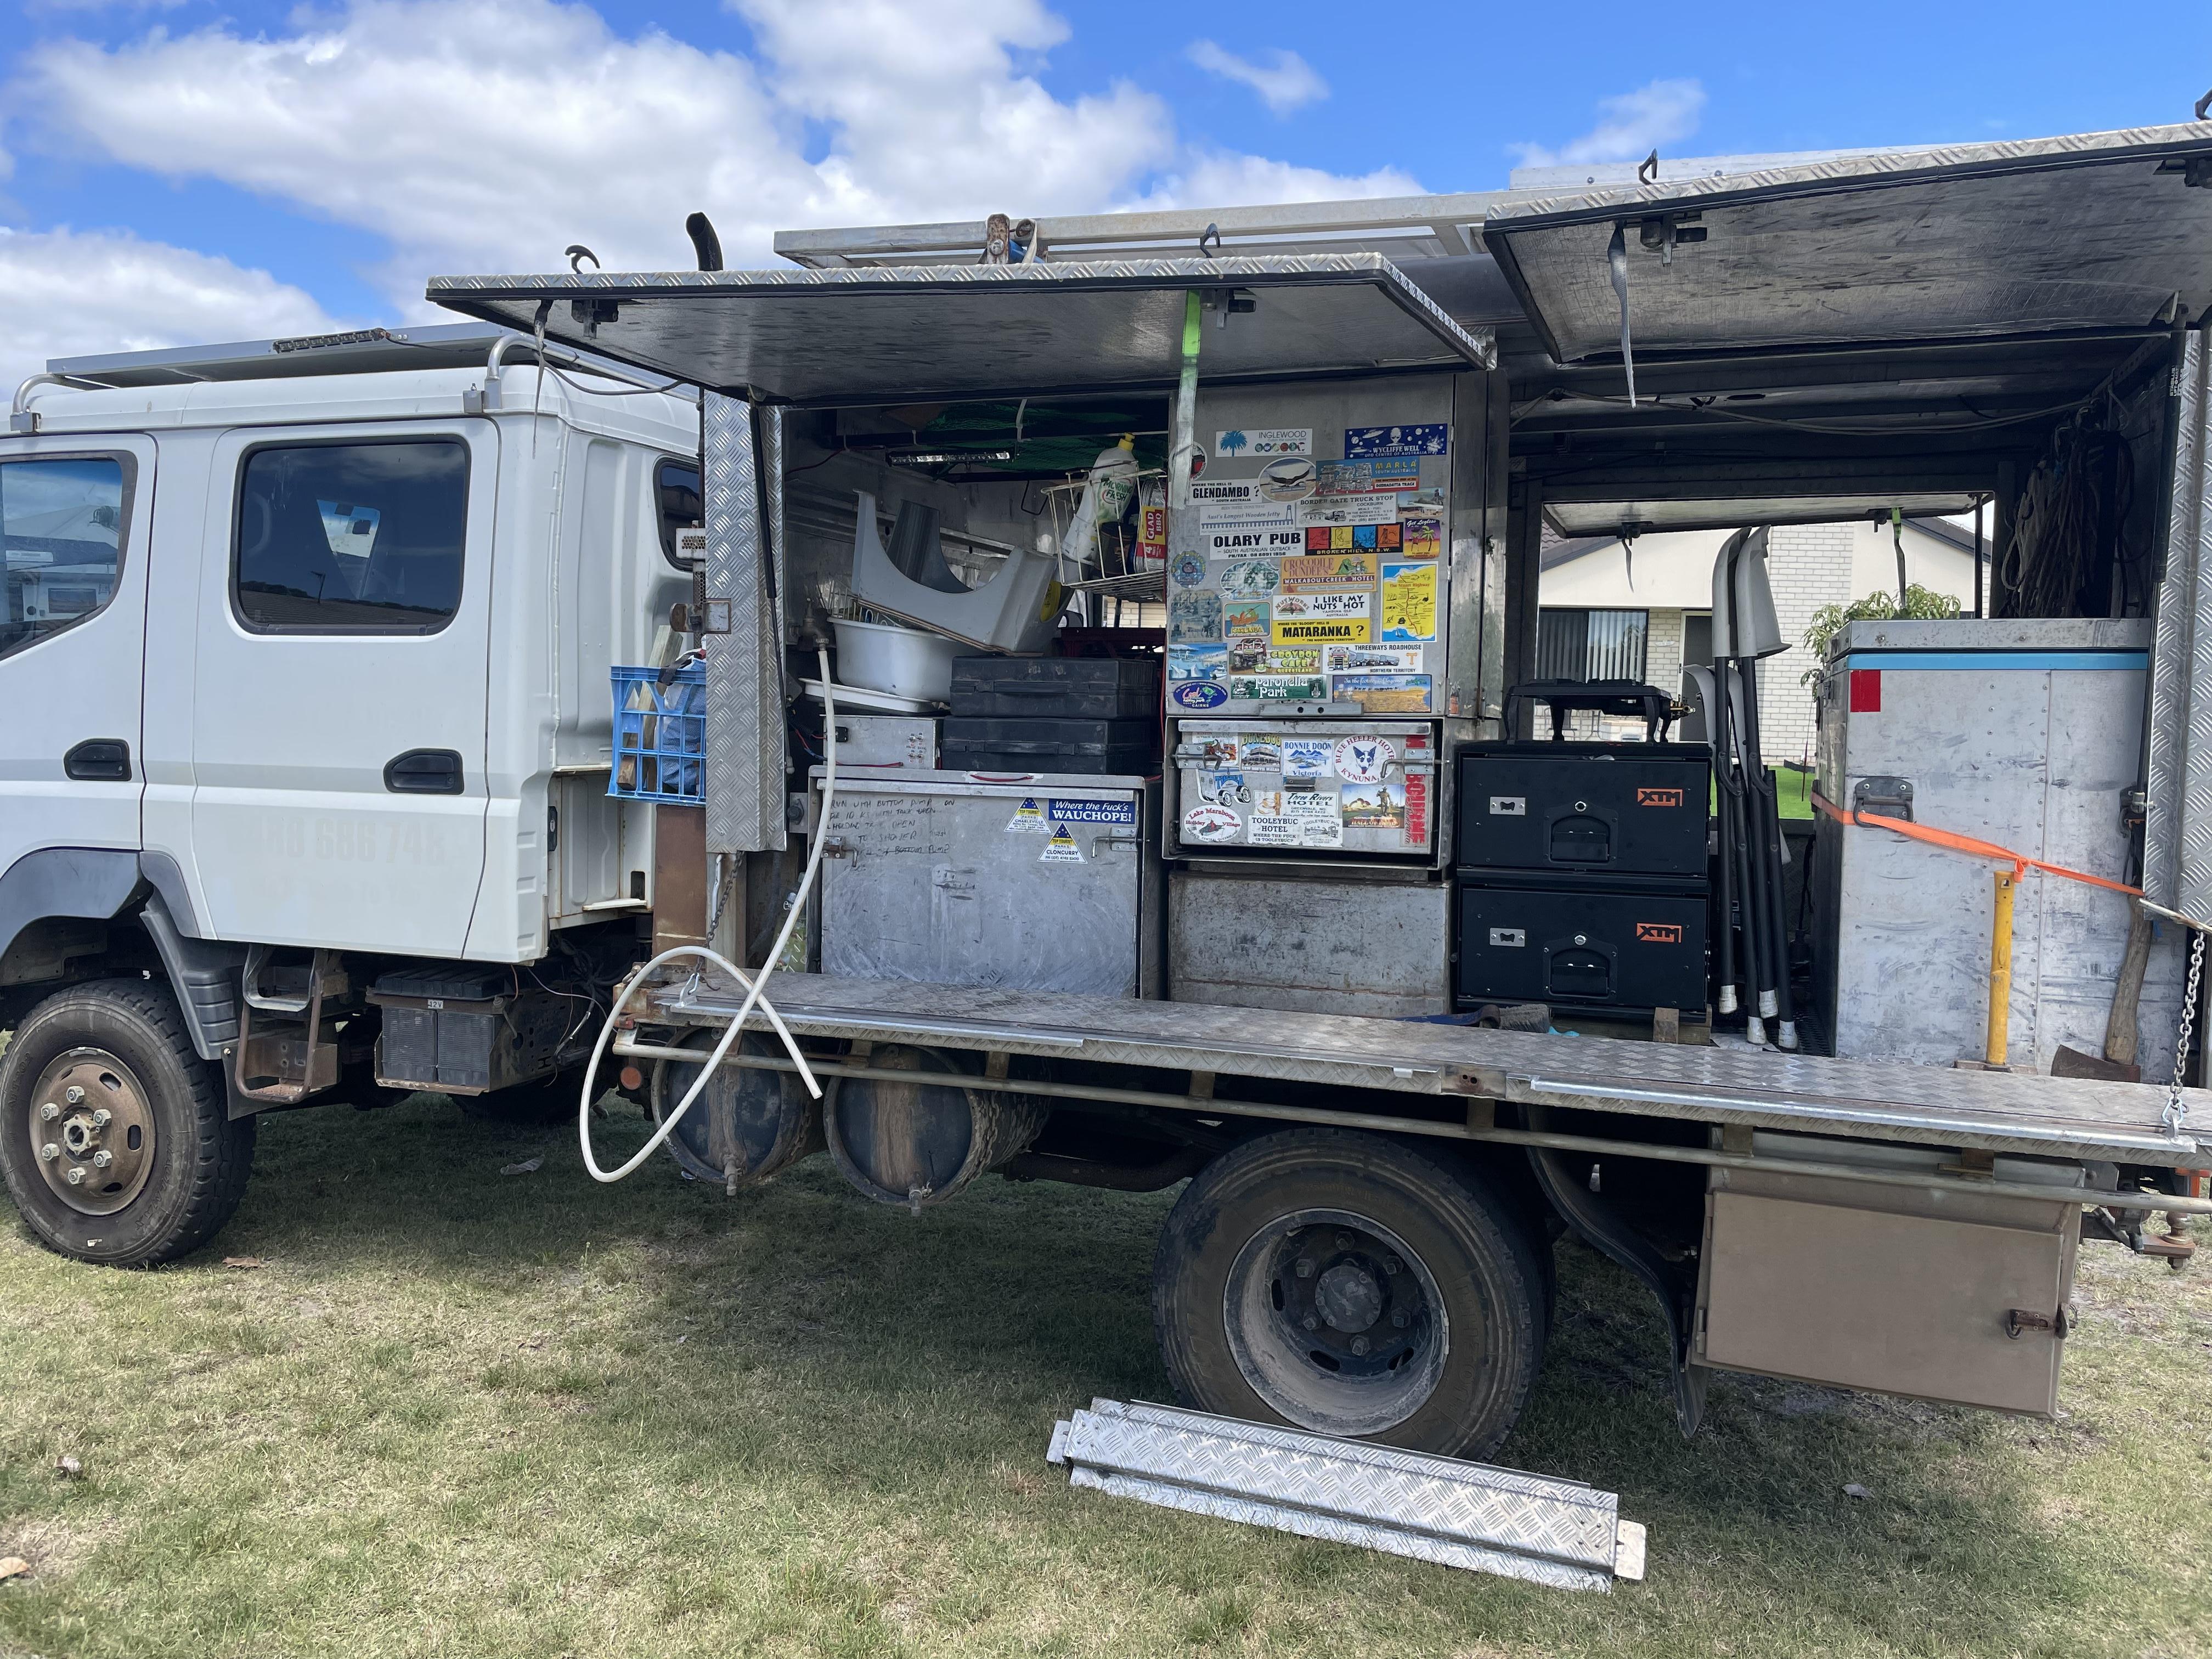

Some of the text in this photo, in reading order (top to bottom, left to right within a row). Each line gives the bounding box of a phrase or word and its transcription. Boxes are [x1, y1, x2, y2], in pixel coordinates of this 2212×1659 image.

[1375, 461, 1417, 469] MARLA
[1193, 486, 1249, 498] GLENDAMBO
[1254, 486, 1259, 496] ?
[1214, 533, 1301, 548] OLARY PUB
[1284, 558, 1334, 572] CROCODILE
[1290, 567, 1328, 577] DUNDEE'S
[1283, 625, 1364, 637] MATARANKA ?
[1255, 677, 1307, 689] Paronella
[1259, 687, 1287, 698] Park
[1335, 735, 1395, 764] BLUE HEELER HOTE
[1406, 735, 1426, 844] MBOURNE
[831, 799, 847, 808] RUN
[1639, 791, 1680, 806] XTM
[1056, 801, 1083, 809] Where
[1103, 802, 1128, 811] Fuck's
[1052, 810, 1132, 822] WAUCHOPE!
[1188, 808, 1235, 821] Lake Maraboon
[1638, 926, 1679, 944] XTM
